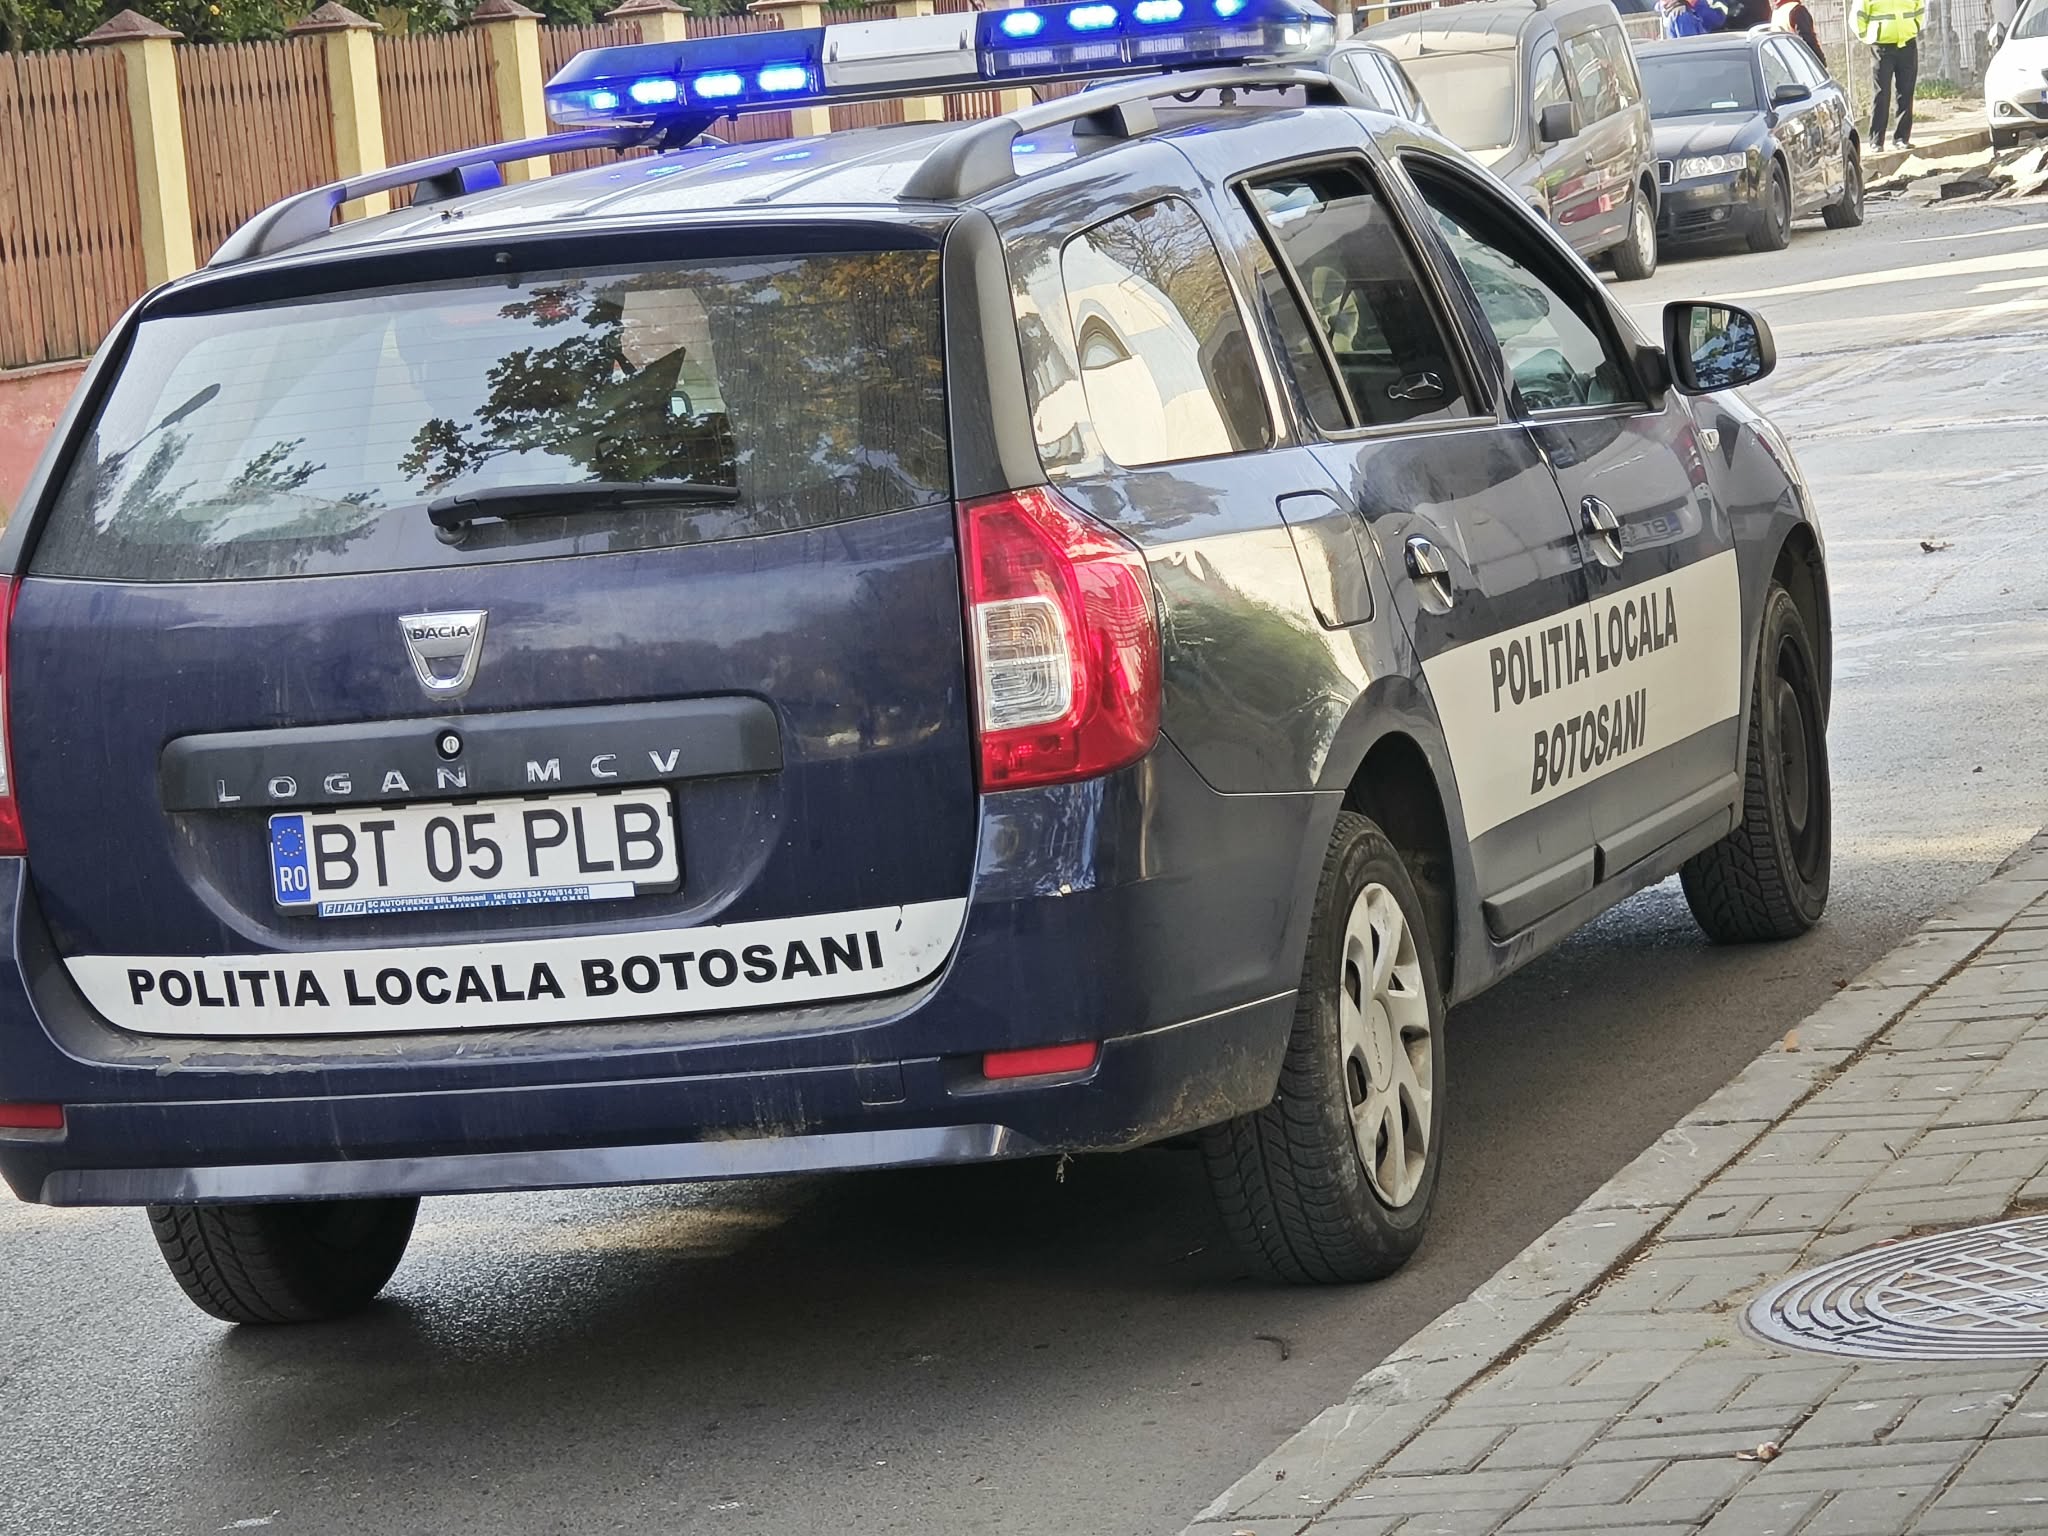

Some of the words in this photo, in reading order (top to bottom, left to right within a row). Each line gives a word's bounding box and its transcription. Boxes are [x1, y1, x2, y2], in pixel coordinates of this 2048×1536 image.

[413, 626, 470, 640] DACIA
[1489, 618, 1590, 712] POLITIA
[1594, 587, 1678, 674] LOCALA
[1531, 688, 1647, 795] BOTOSANI
[217, 766, 468, 803] LOGAN
[527, 749, 681, 784] MCV
[280, 866, 307, 892] RO
[312, 820, 395, 891] BT
[424, 812, 503, 884] 05
[523, 802, 664, 877] PLB
[326, 901, 364, 914] FIAT
[127, 968, 331, 1009] POLITIA
[339, 963, 564, 1007] LOCALA
[582, 930, 884, 998] BOTOSANI
